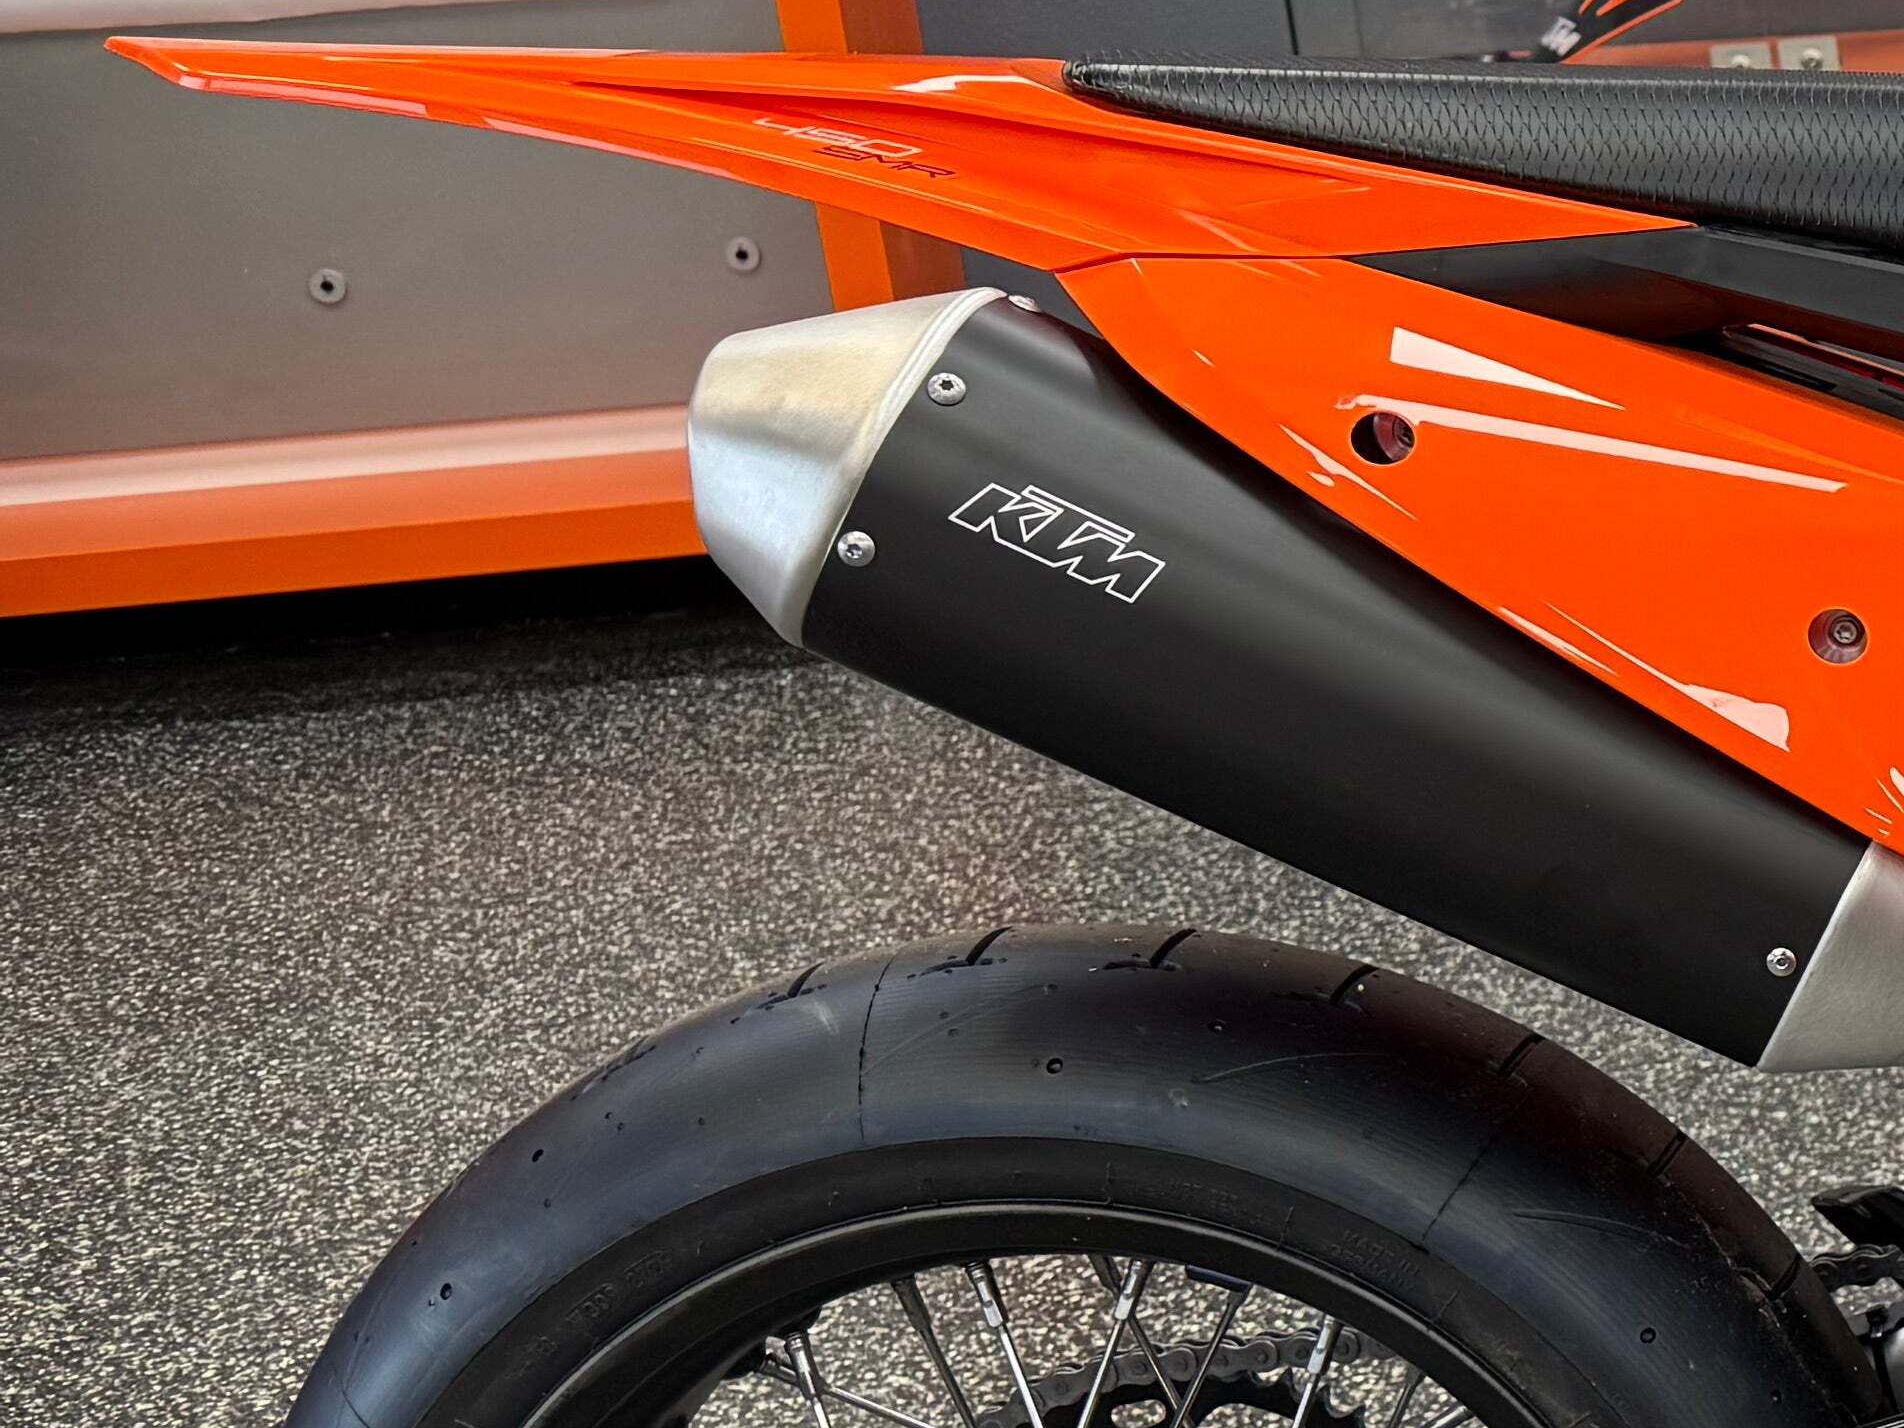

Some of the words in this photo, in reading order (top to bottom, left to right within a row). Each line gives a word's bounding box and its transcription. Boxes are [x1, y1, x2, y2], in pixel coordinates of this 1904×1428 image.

[752, 118, 924, 158] 450
[811, 145, 956, 178] SMR
[947, 483, 1166, 604] KTM
